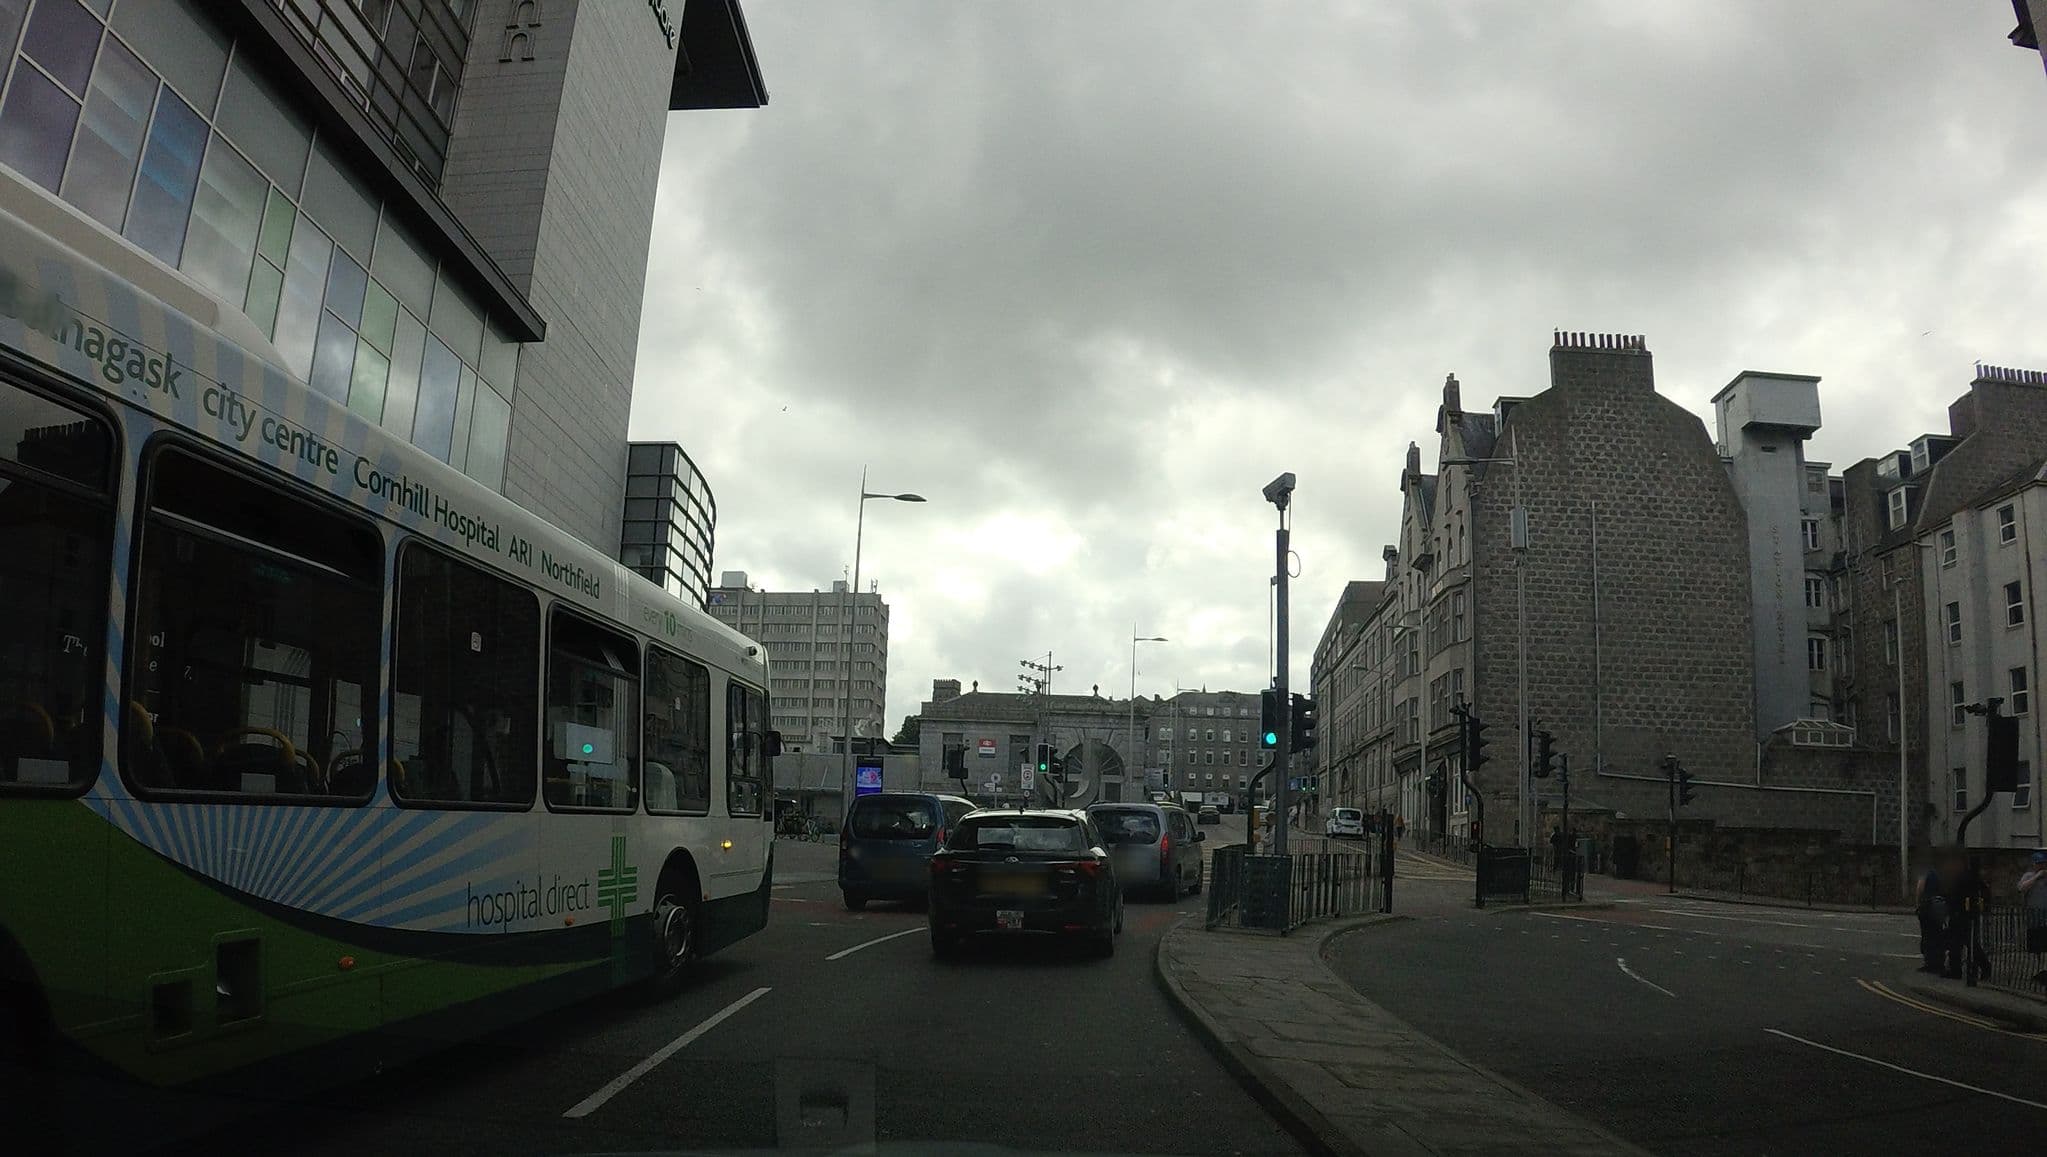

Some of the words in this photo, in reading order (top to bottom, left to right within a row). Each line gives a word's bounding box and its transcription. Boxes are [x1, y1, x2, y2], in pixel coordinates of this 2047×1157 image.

[203, 381, 257, 442] city
[261, 413, 339, 475] centre
[353, 455, 430, 519] Cornhill
[434, 495, 501, 553] Hospital
[508, 534, 533, 568] ARI
[541, 549, 600, 600] Northfield
[664, 610, 676, 637] 10
[467, 874, 543, 934] hospital
[546, 873, 590, 916] direct
